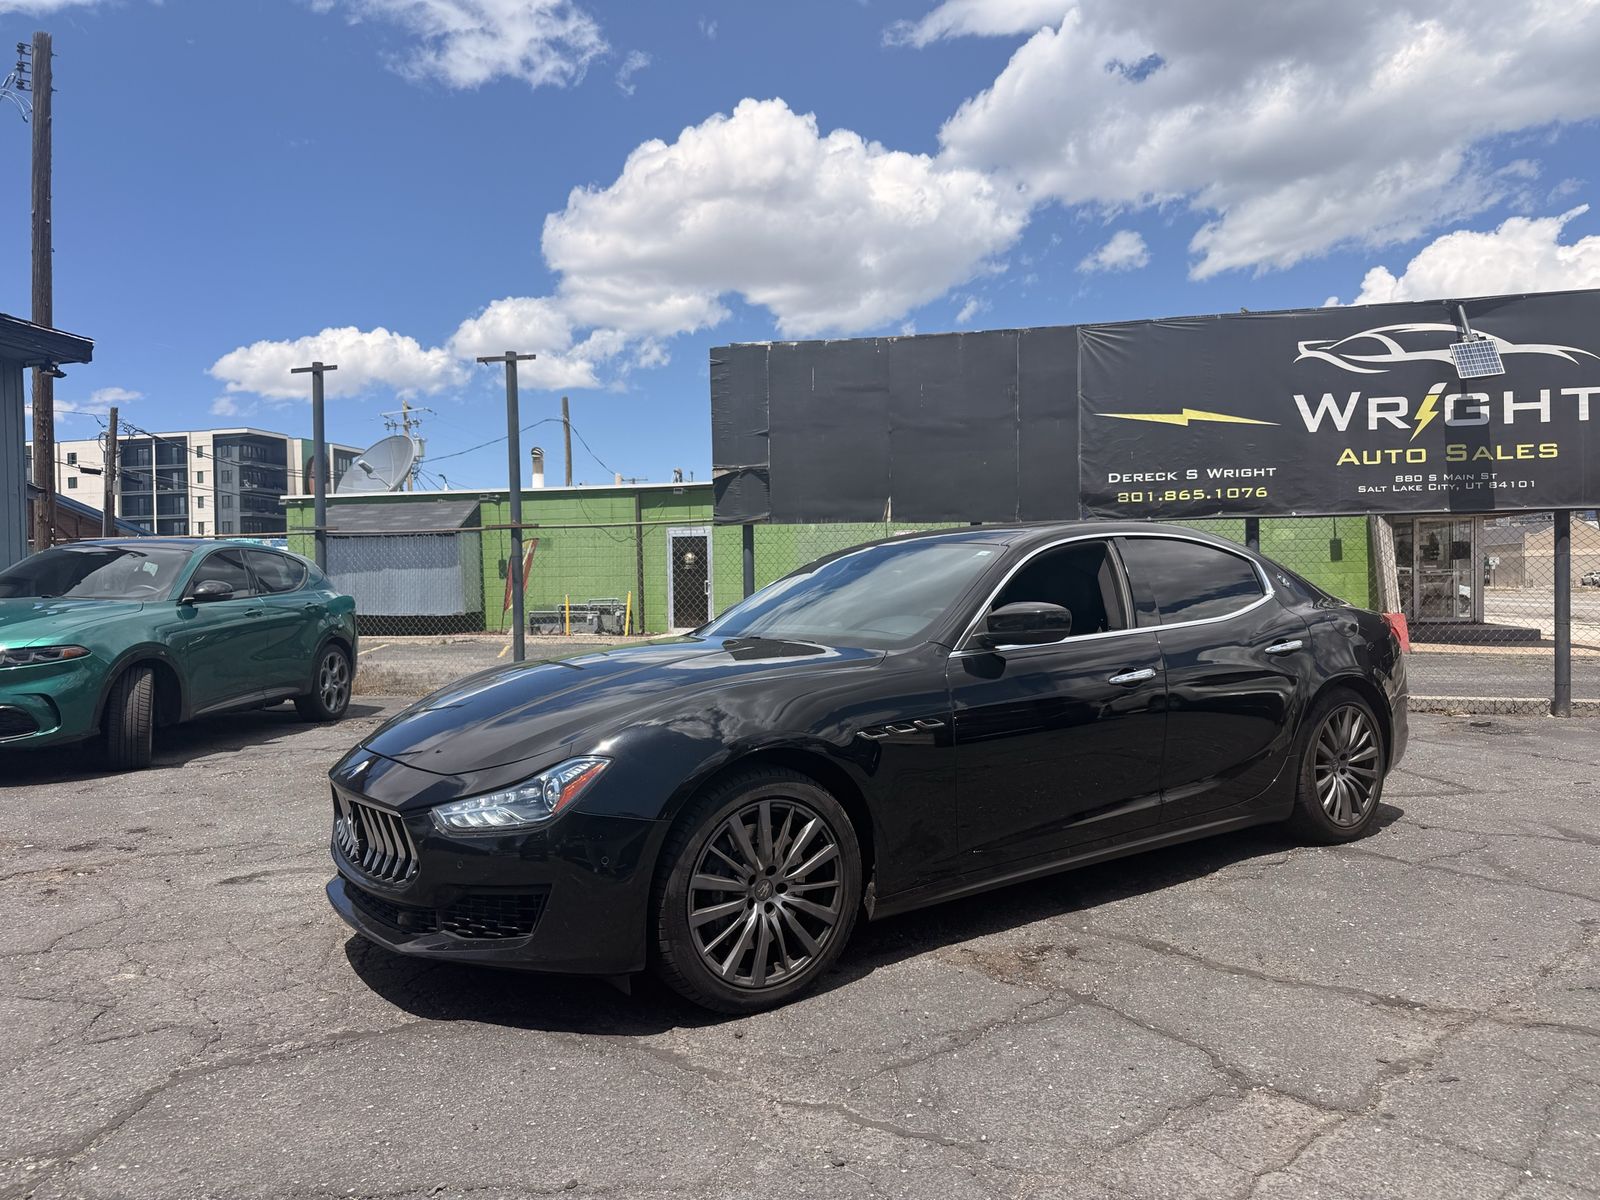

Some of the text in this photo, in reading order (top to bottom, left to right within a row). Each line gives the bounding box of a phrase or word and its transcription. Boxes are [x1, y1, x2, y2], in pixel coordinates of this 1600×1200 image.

[1336, 442, 1559, 466] AUTO SALES
[1108, 467, 1277, 483] DERECK S WRIGHT
[1395, 472, 1498, 482] 880 S MAIN ST
[1358, 480, 1536, 493] SALT LAKE CITY, UT 84101
[1117, 487, 1268, 503] 301.865.1076
